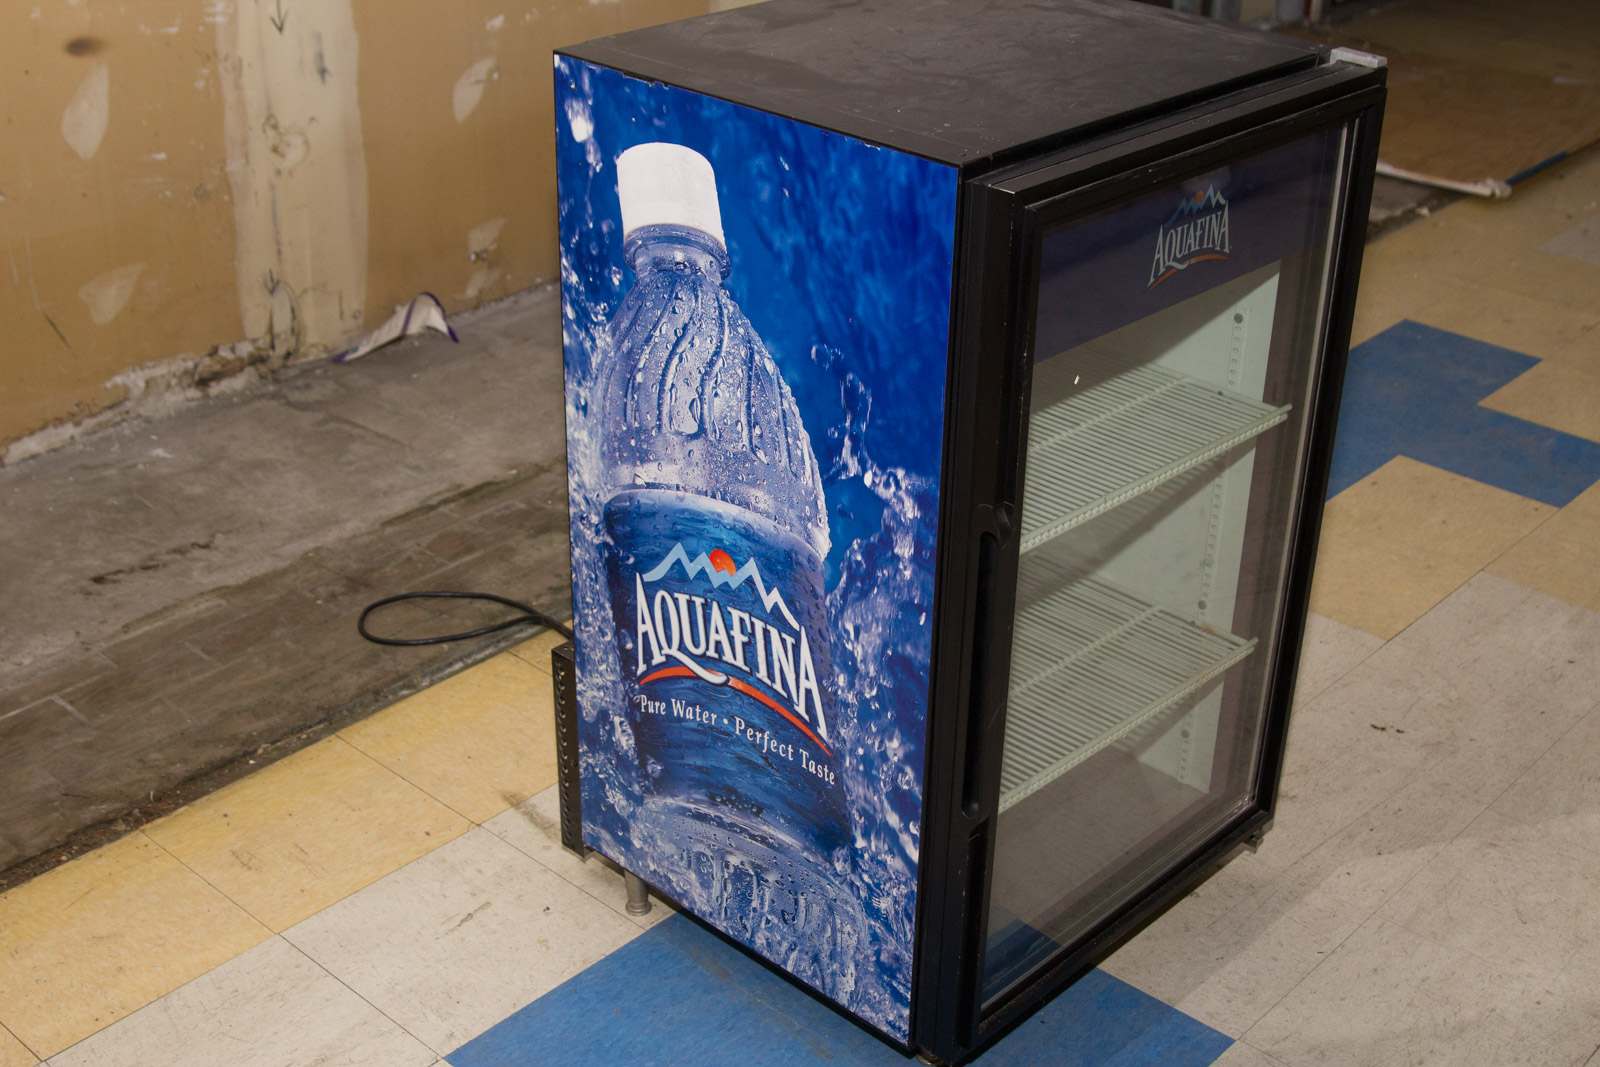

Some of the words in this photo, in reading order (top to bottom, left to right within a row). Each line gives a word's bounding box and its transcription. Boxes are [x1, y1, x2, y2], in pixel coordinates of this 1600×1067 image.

[1147, 199, 1230, 287] AQUAFINA
[636, 572, 828, 744] AQUAFINA
[637, 695, 666, 715] Pure
[671, 698, 717, 726] Water
[734, 716, 794, 761] Perfect
[799, 748, 836, 785] Taste
